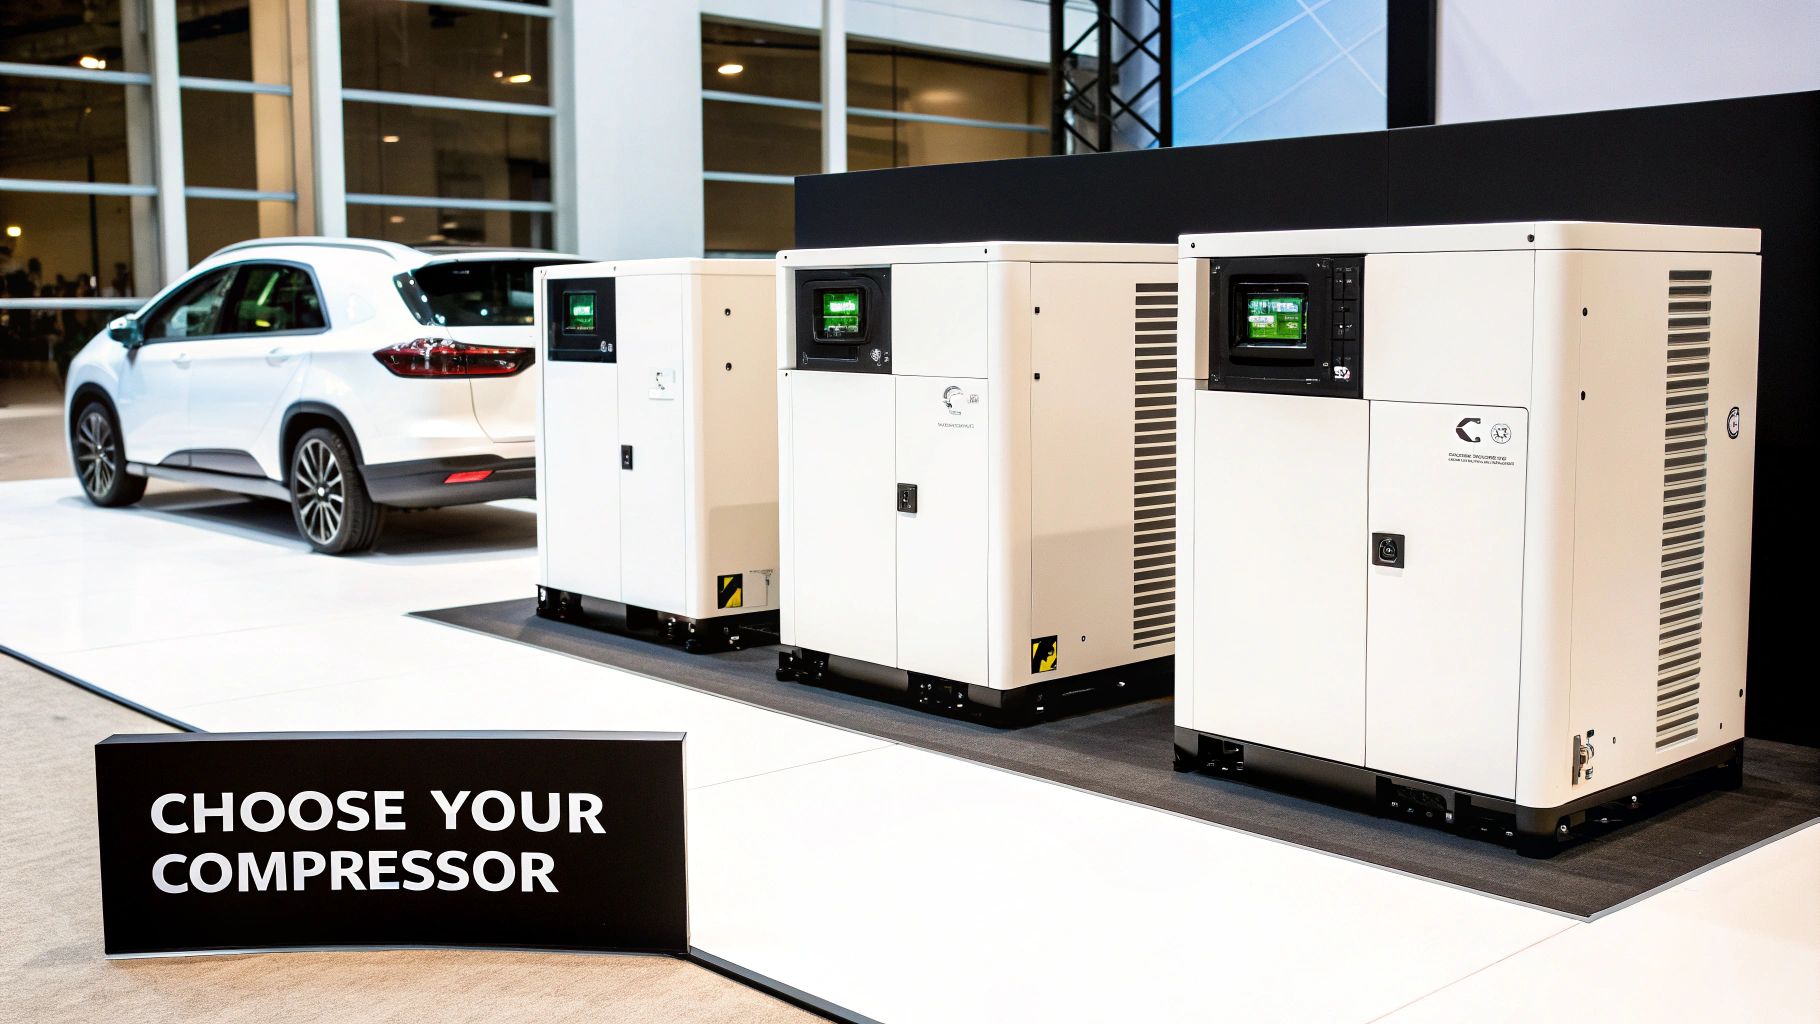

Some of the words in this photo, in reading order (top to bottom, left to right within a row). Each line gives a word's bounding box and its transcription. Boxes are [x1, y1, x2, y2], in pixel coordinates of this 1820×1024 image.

[150, 790, 406, 834] CHOOSE
[430, 789, 607, 834] YOUR
[152, 849, 560, 894] COMPRESSOR
